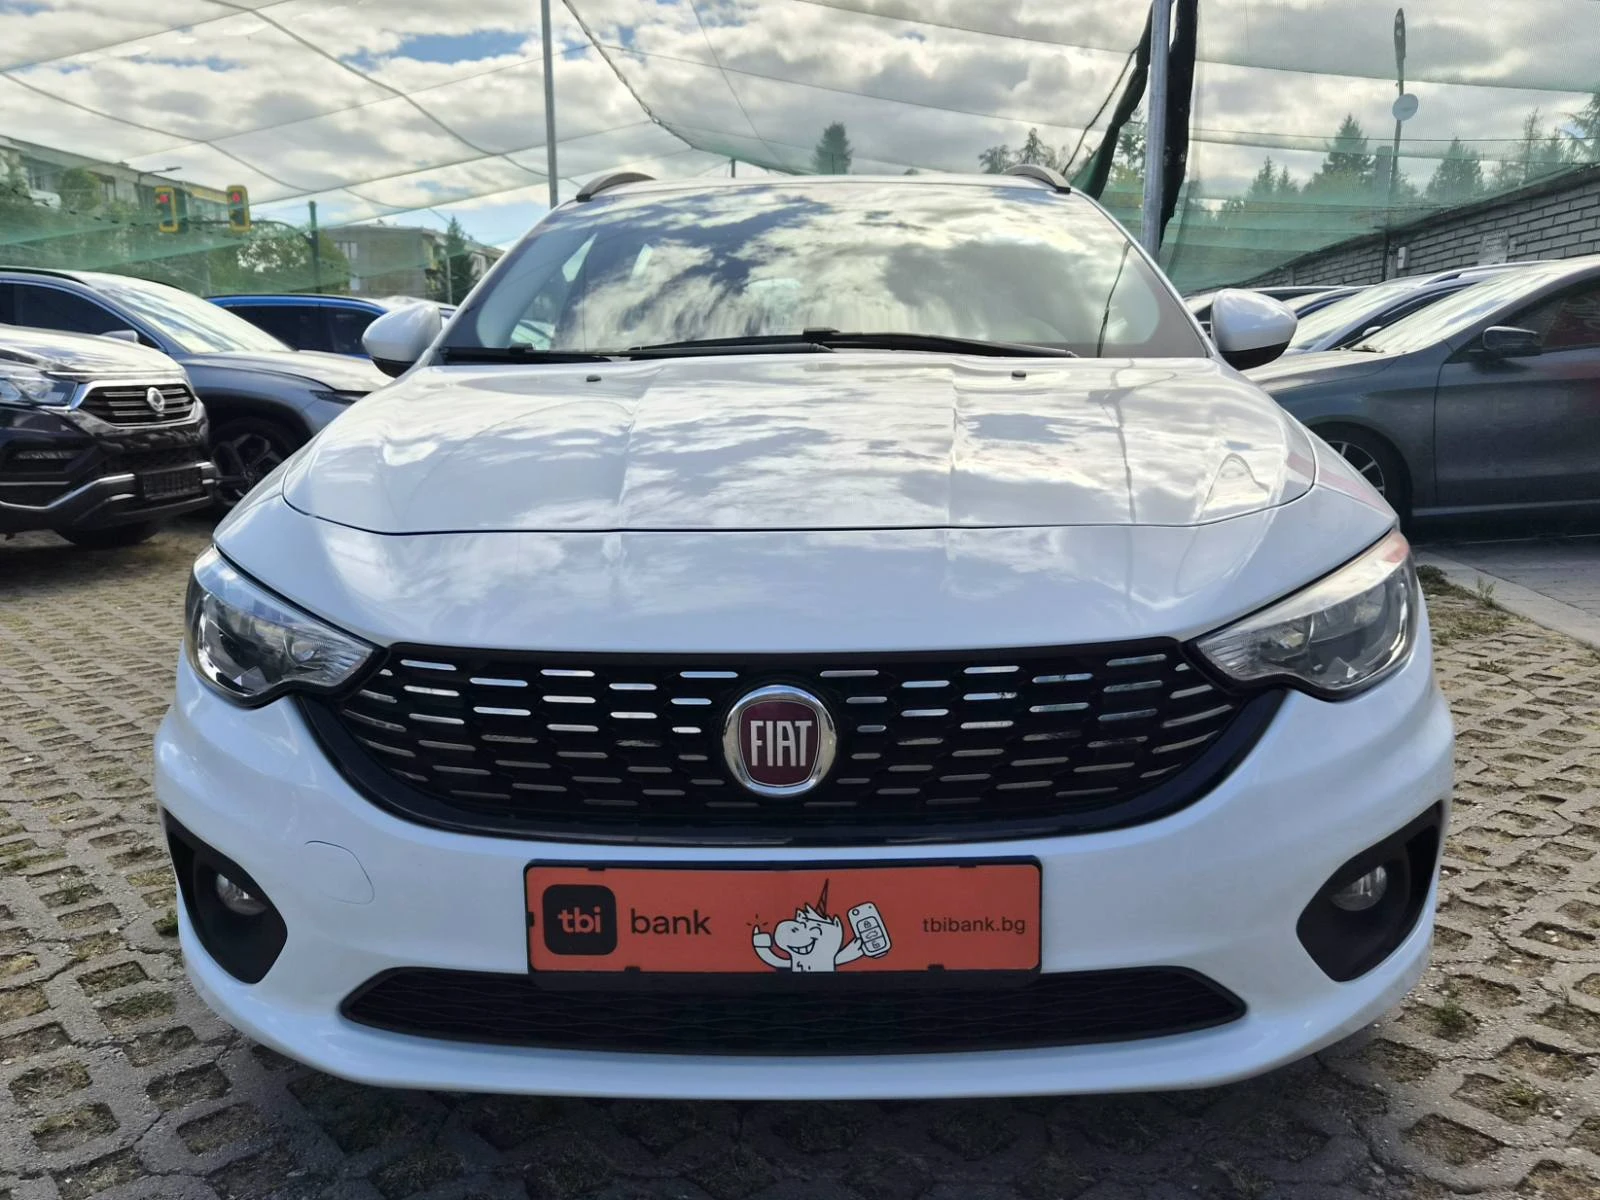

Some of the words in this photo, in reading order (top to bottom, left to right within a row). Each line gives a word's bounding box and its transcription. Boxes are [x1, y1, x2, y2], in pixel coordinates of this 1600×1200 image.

[750, 720, 812, 767] FIAT
[558, 906, 602, 934] tbi
[630, 908, 712, 935] bank
[923, 916, 1025, 935] tbibank.bg
